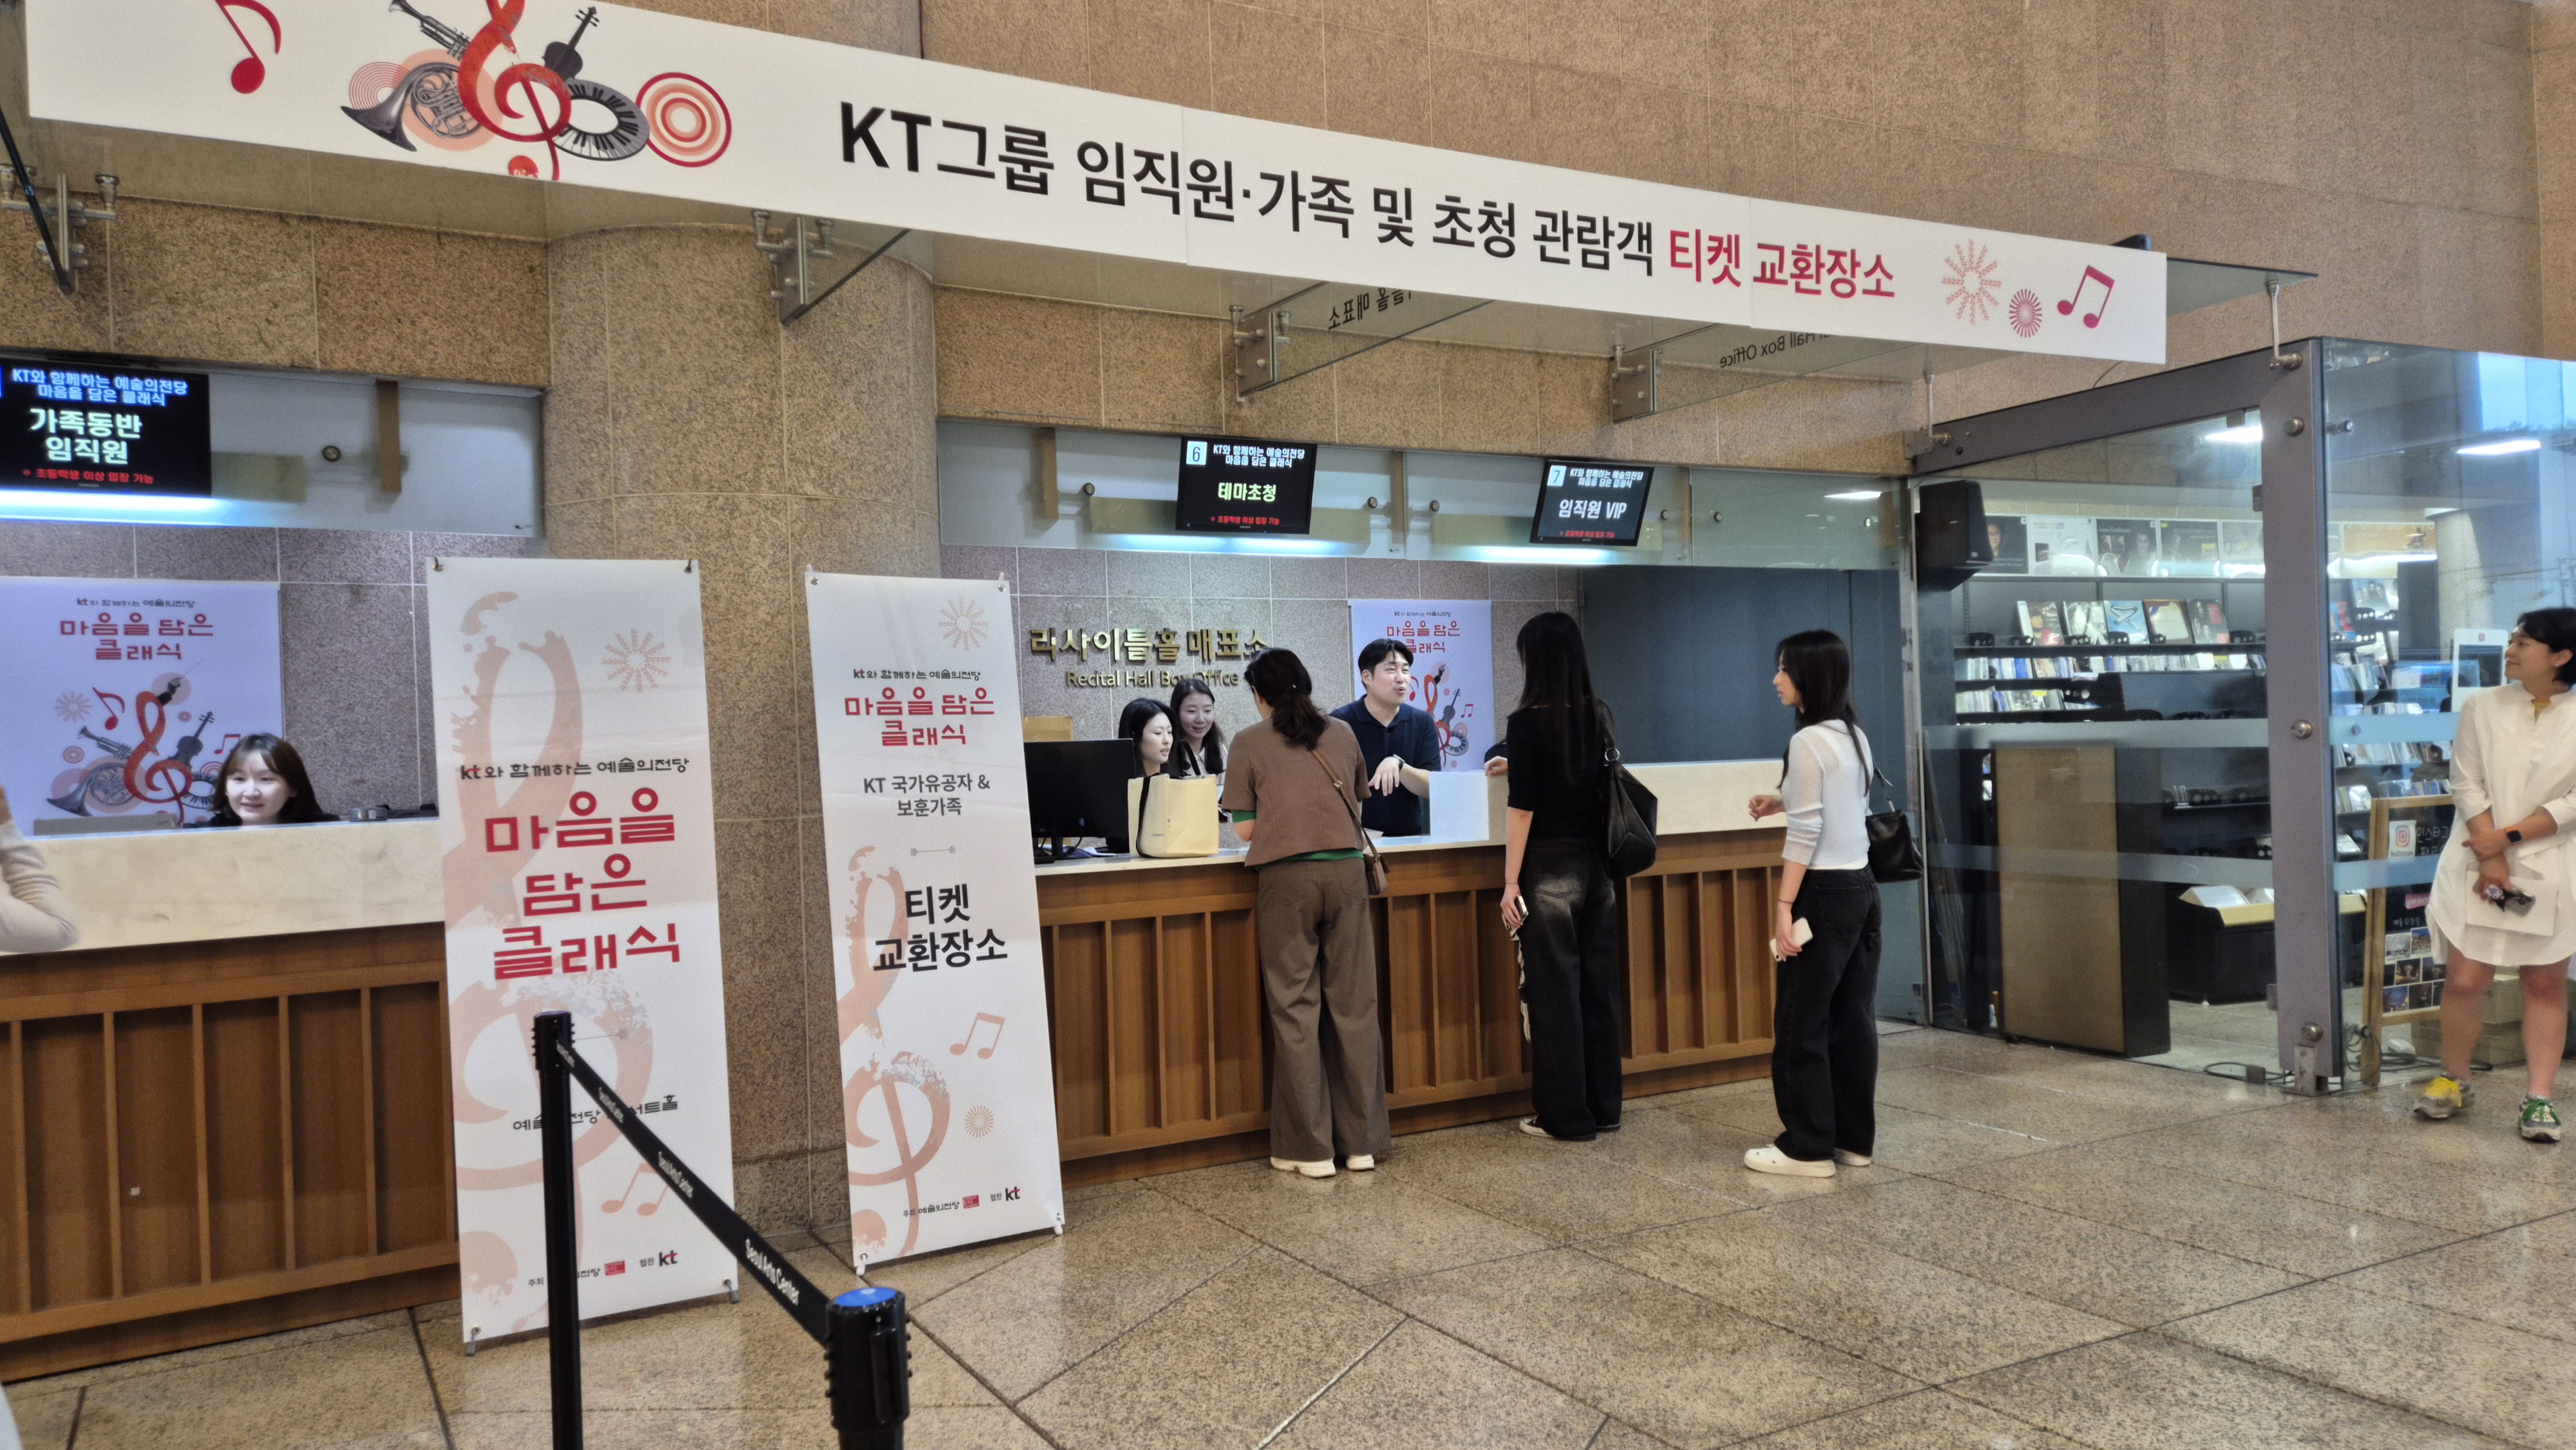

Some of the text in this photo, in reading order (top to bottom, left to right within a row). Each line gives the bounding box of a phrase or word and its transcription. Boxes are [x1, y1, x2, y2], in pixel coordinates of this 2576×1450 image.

[840, 101, 1054, 196] KT그룹
[1372, 187, 1416, 247] 및
[1432, 195, 1517, 258] 초청
[1532, 209, 1654, 277] 관람객
[1669, 229, 1742, 288] 티켓
[1752, 243, 1896, 299] 교환장소
[13, 369, 188, 395] KT와 함께하는 예술의전당
[38, 384, 166, 406] 마음을 담은 클래식
[30, 408, 142, 438] 가족동반
[46, 437, 128, 464] 임직원
[1192, 446, 1201, 462] 6
[1553, 470, 1561, 483] 7
[1218, 482, 1276, 502] 테마초청
[1558, 499, 1627, 519] 임직원 VIP
[61, 612, 213, 636] 마음을 담은
[1387, 620, 1460, 636] 마음을 담은
[95, 639, 182, 660] 클래식
[1030, 628, 1268, 661] 리사이틀홀 매표소
[1405, 639, 1445, 653] 클래식
[881, 670, 927, 679] 함께하는
[929, 669, 981, 681] 예술의전당
[1066, 670, 1120, 686] Recital
[1126, 670, 1153, 686] Hall
[844, 687, 994, 715] 마음을 담은
[882, 720, 966, 746] 클래식
[509, 762, 592, 778] 함께하는
[597, 757, 690, 773] 예술의전당
[864, 773, 990, 793] KT 국가유공자 &
[897, 798, 962, 816] 보훈가족
[485, 787, 675, 852] 마음을
[523, 853, 647, 916] 담은
[905, 883, 971, 925] 티켓
[494, 923, 680, 980] 클래식
[873, 928, 1008, 972] 교환장소
[1005, 1186, 1020, 1201] kt
[918, 1201, 960, 1214] 예술의전당
[658, 1250, 677, 1266] kt
[528, 1277, 544, 1286] 주최
